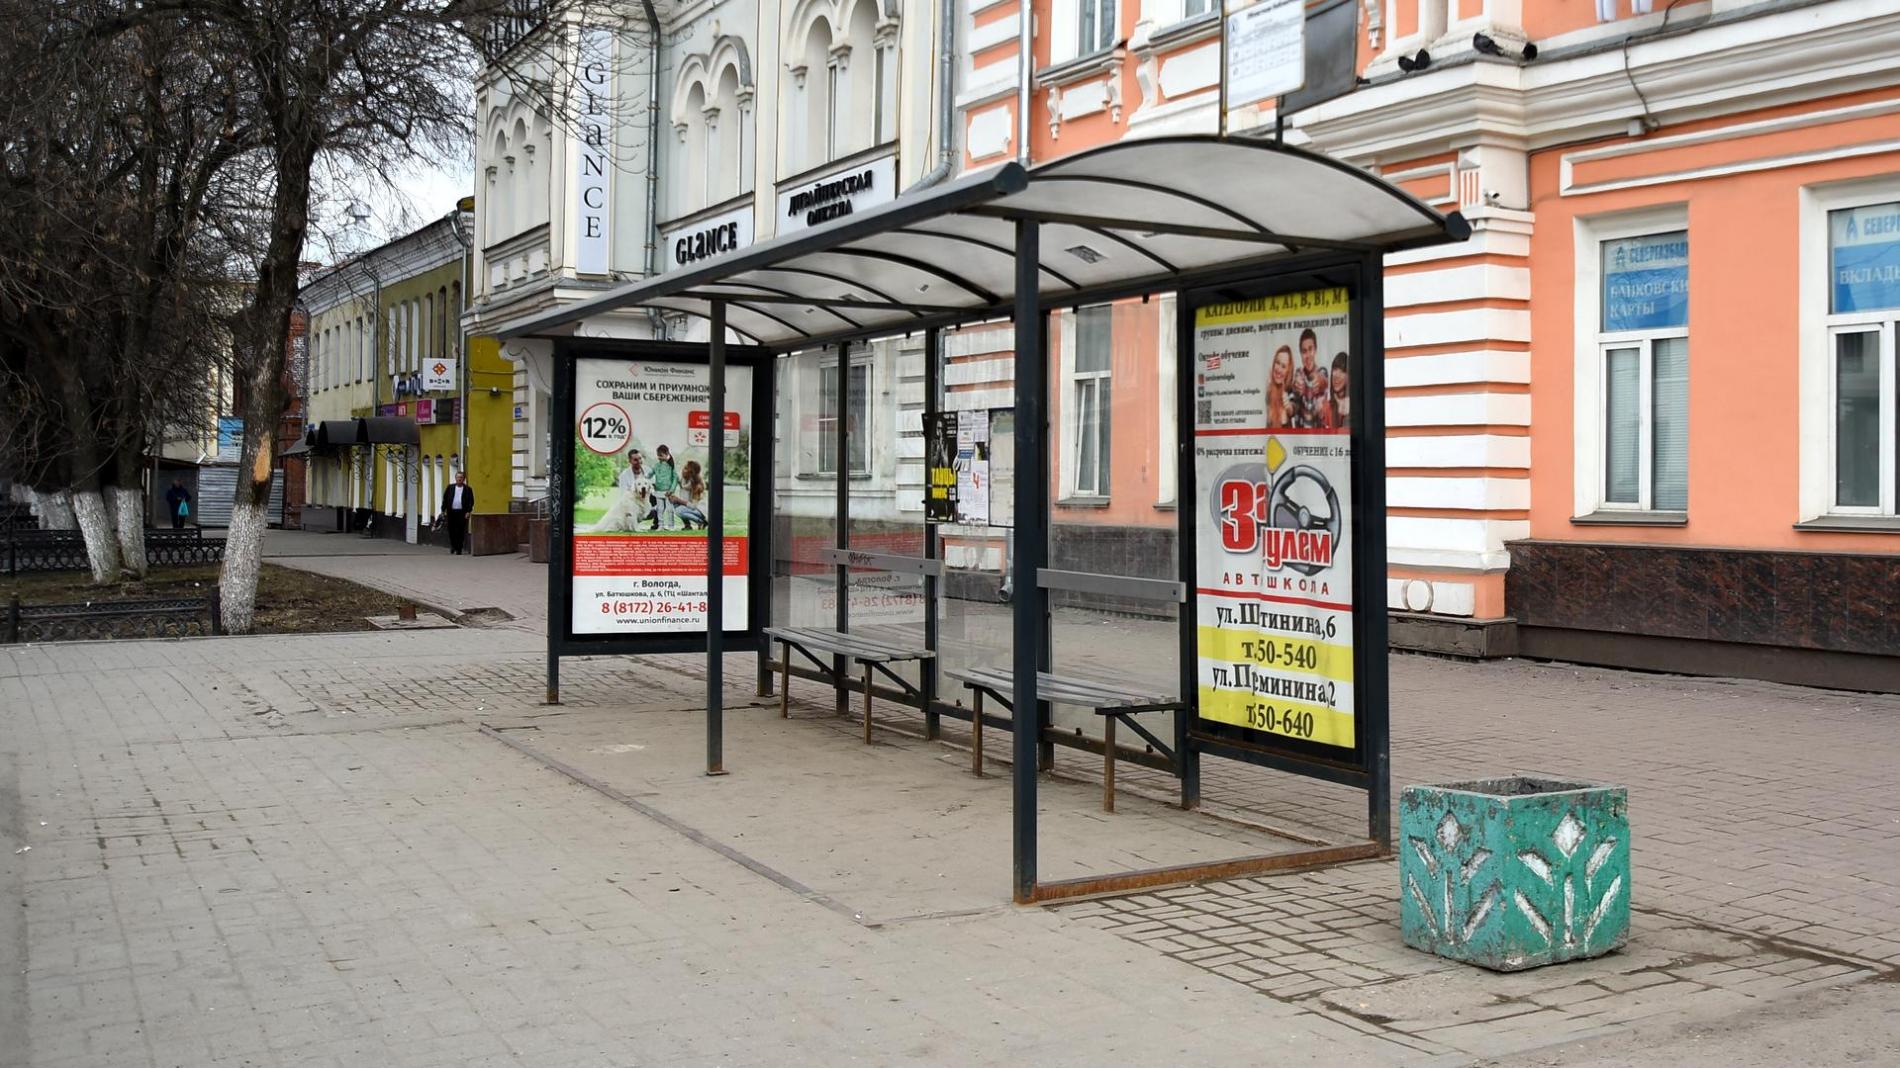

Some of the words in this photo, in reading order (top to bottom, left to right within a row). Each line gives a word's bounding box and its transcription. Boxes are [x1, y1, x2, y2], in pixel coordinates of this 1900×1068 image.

[807, 199, 853, 227] ОДЕЖДА
[1610, 301, 1655, 318] КАРТЫ
[596, 379, 648, 391] СОХРАНИМ
[650, 382, 656, 391] И
[612, 391, 641, 401] ВАШИ
[583, 416, 626, 439] 12%
[641, 580, 681, 590] Вологда,
[601, 602, 610, 613] 8
[614, 601, 653, 615] (8172)
[616, 616, 700, 625] www.unionfinance.ru
